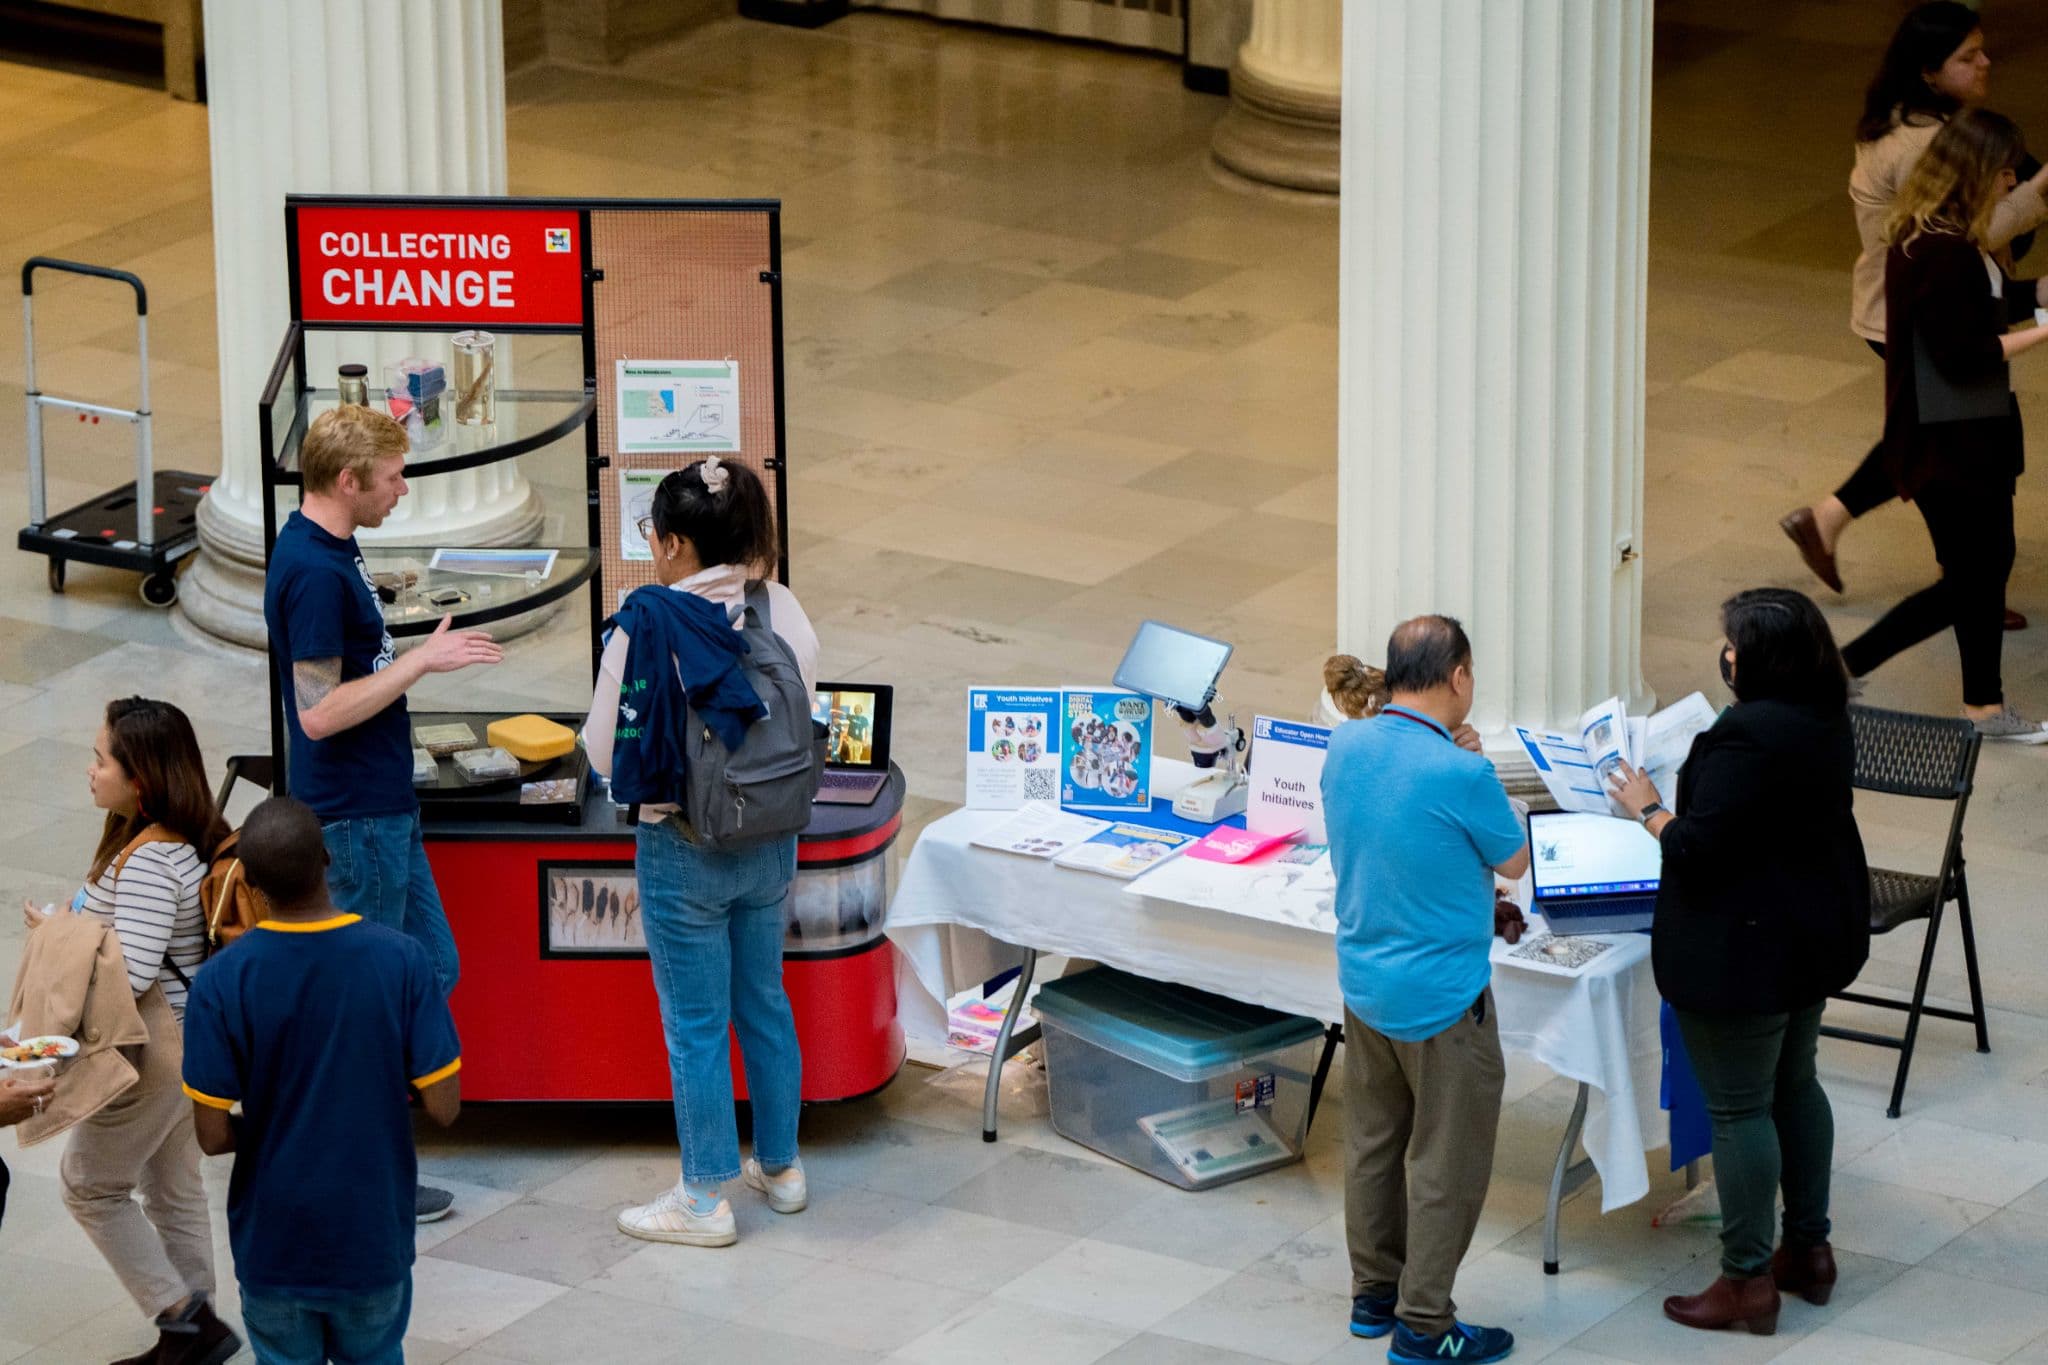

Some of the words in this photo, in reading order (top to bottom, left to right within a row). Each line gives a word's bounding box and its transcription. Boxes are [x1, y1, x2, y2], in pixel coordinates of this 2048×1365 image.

[320, 231, 511, 259] COLLECTING
[322, 268, 515, 308] CHANGE
[996, 695, 1018, 703] Youth
[1018, 695, 1053, 704] Initiatives
[1299, 730, 1315, 740] Open
[1315, 732, 1329, 742] Hous
[1274, 777, 1306, 793] Youth
[1262, 791, 1315, 810] Initiatives
[1436, 1334, 1466, 1358] N
